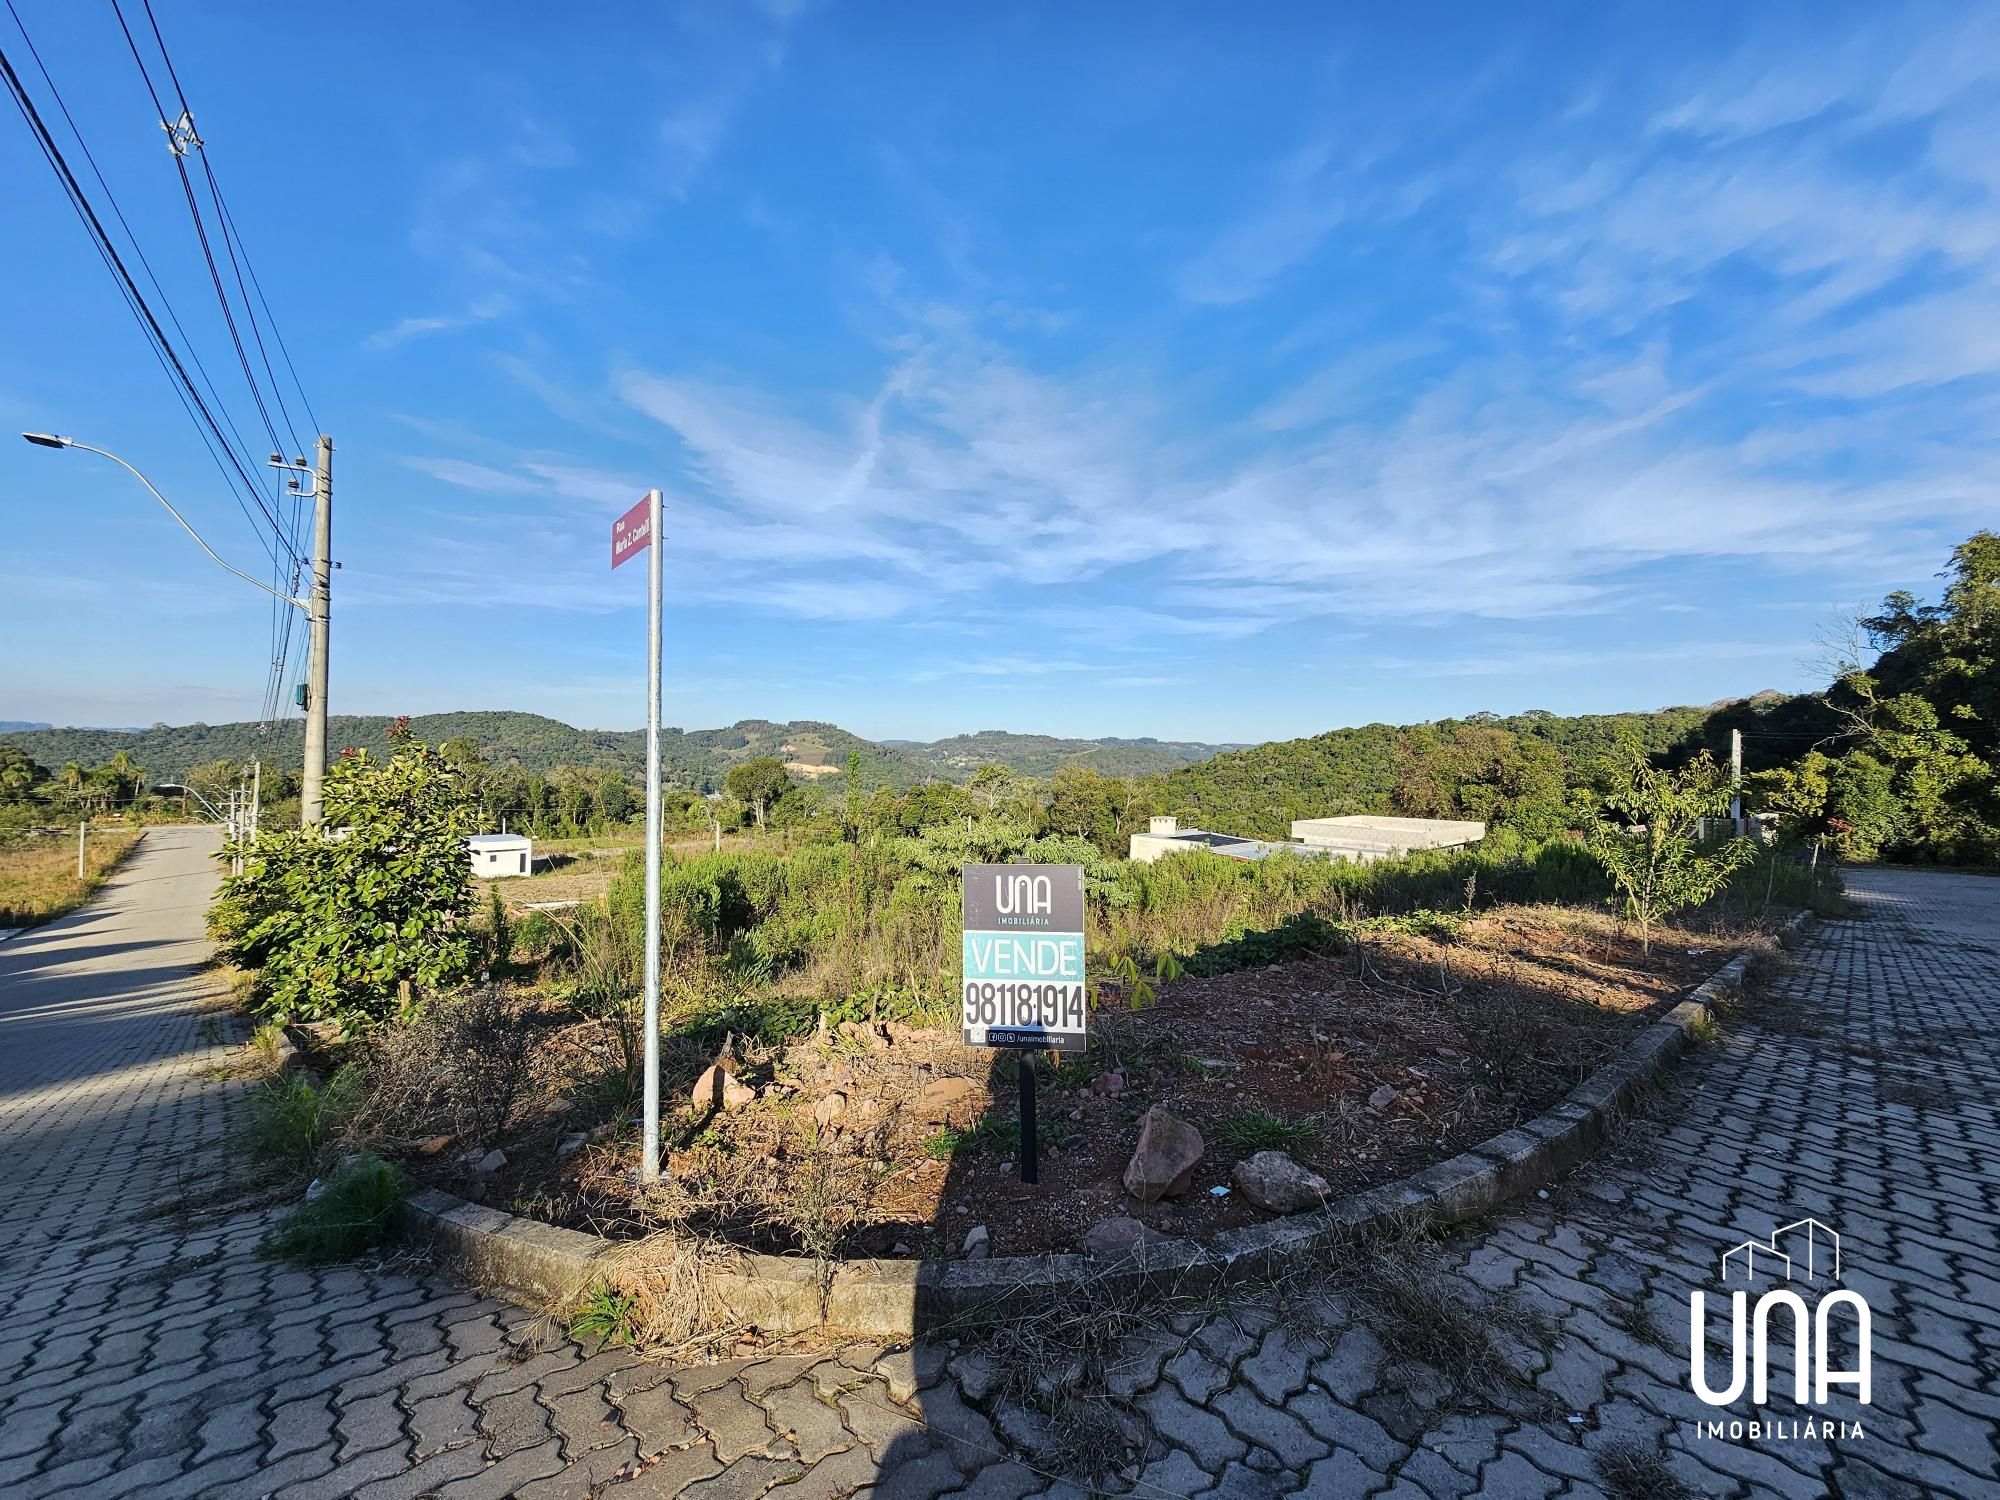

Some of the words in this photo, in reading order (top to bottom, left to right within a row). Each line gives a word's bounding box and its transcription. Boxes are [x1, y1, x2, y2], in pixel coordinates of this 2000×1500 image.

[616, 520, 625, 534] Rua
[995, 874, 1051, 914] UNA
[998, 916, 1049, 926] IMOBILIÁRIA
[970, 938, 1078, 976] VENDE
